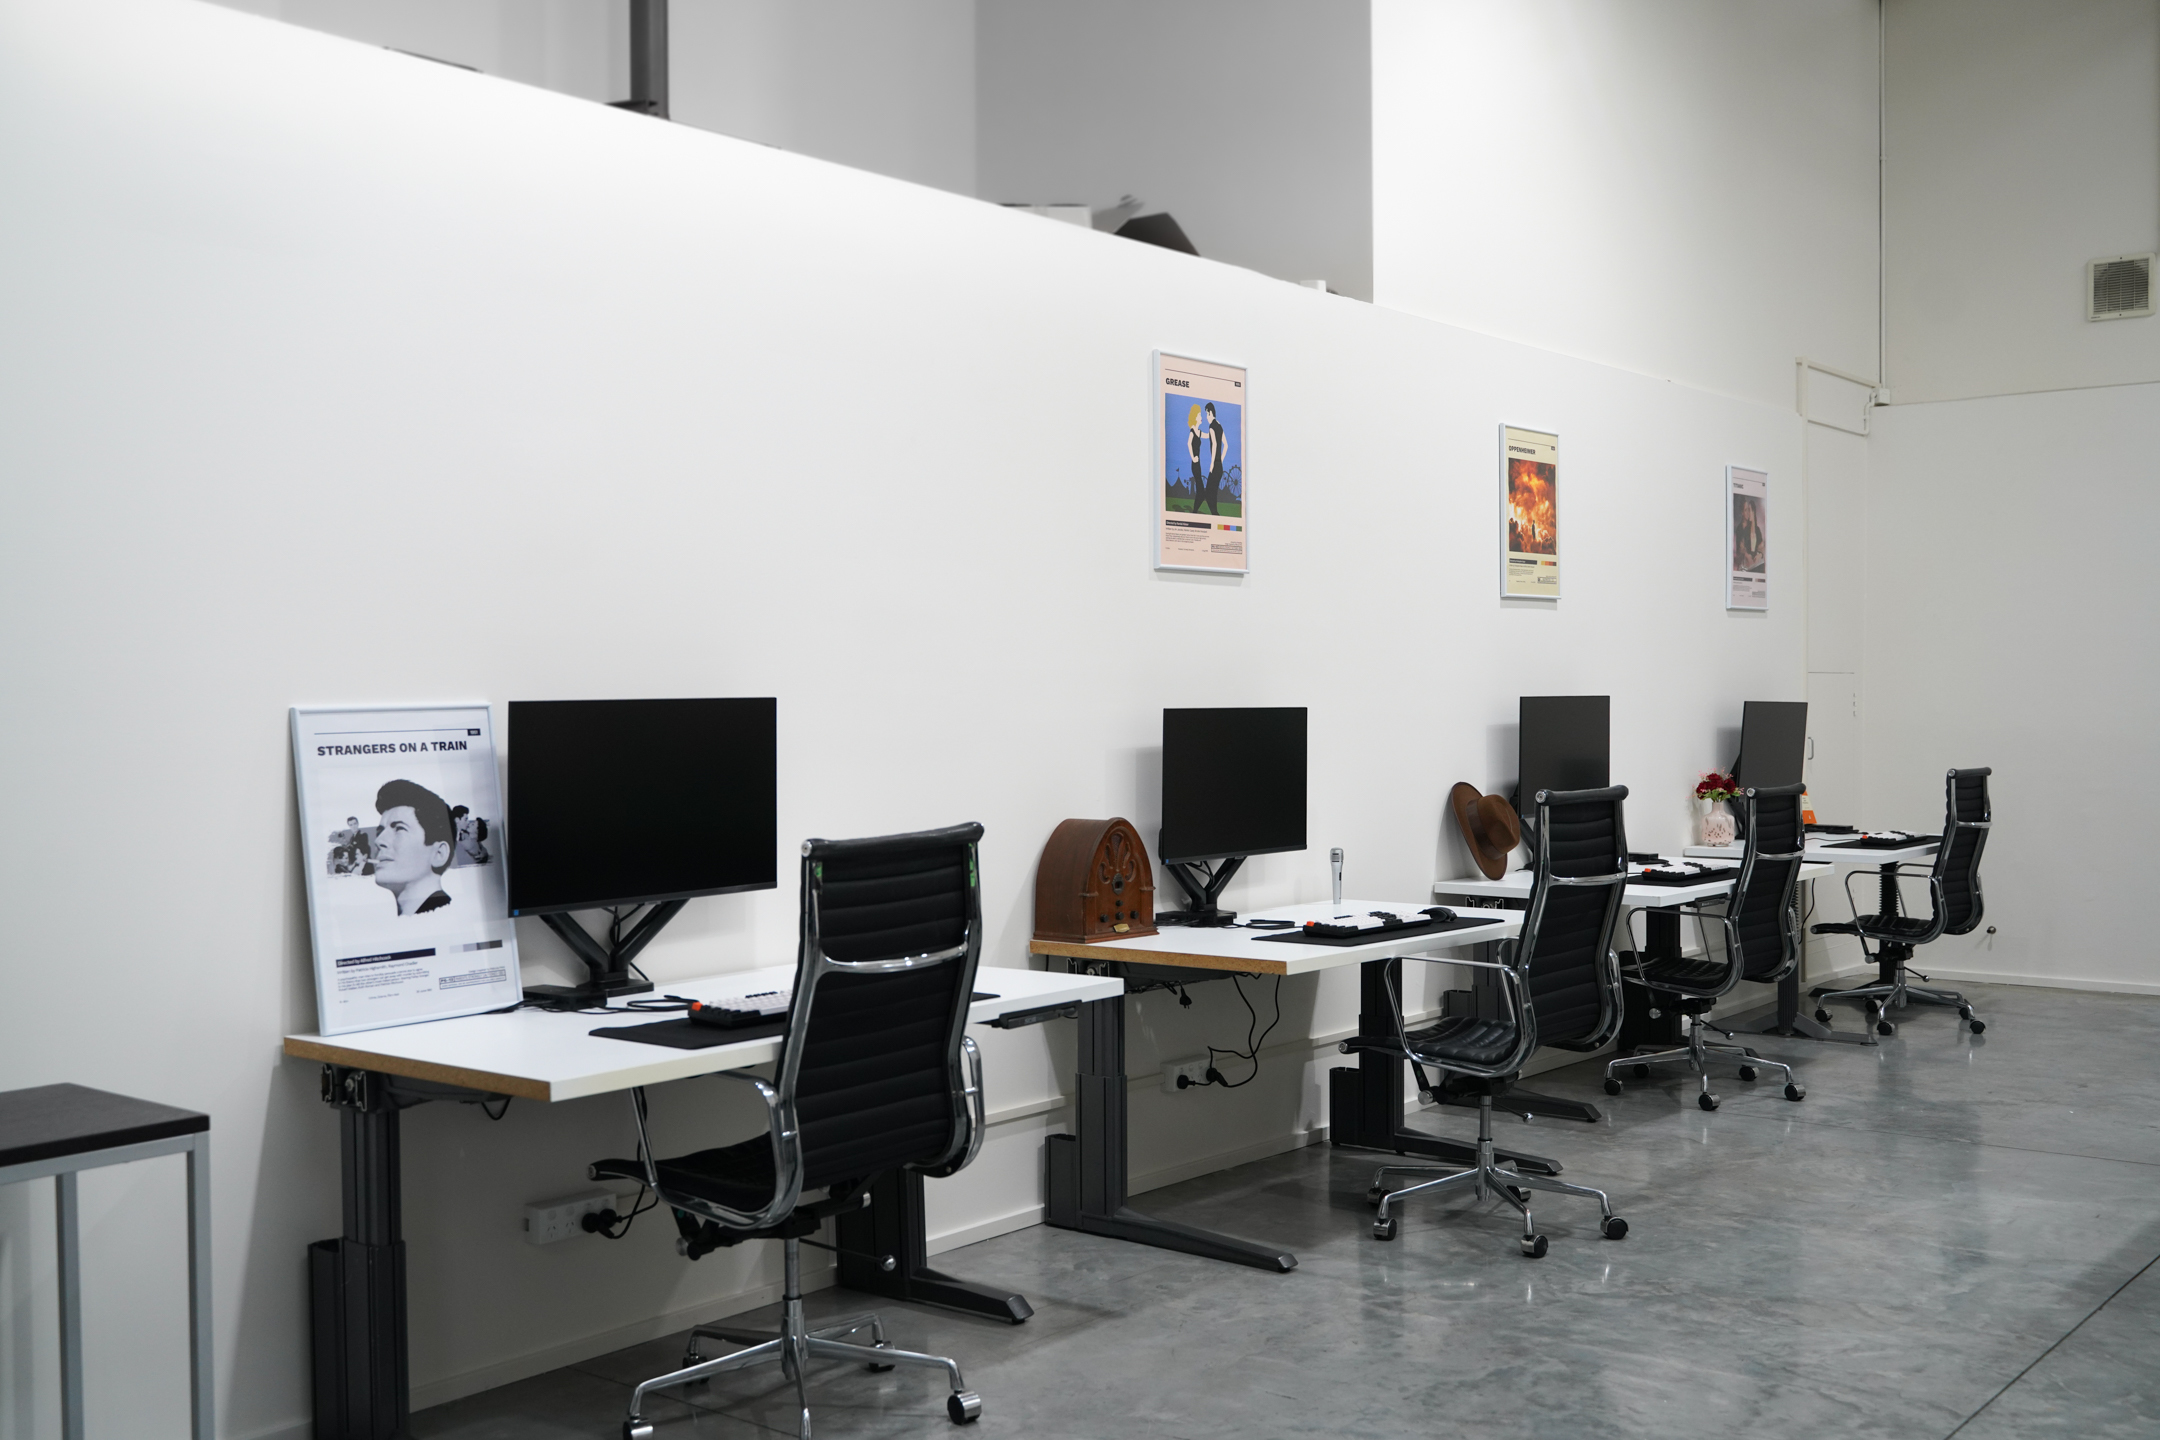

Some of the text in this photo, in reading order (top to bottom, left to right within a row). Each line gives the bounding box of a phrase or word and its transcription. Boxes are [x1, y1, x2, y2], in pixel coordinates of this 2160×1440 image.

[1165, 377, 1190, 388] GREASE
[317, 741, 468, 756] STRANGERS ON A TRAIN
